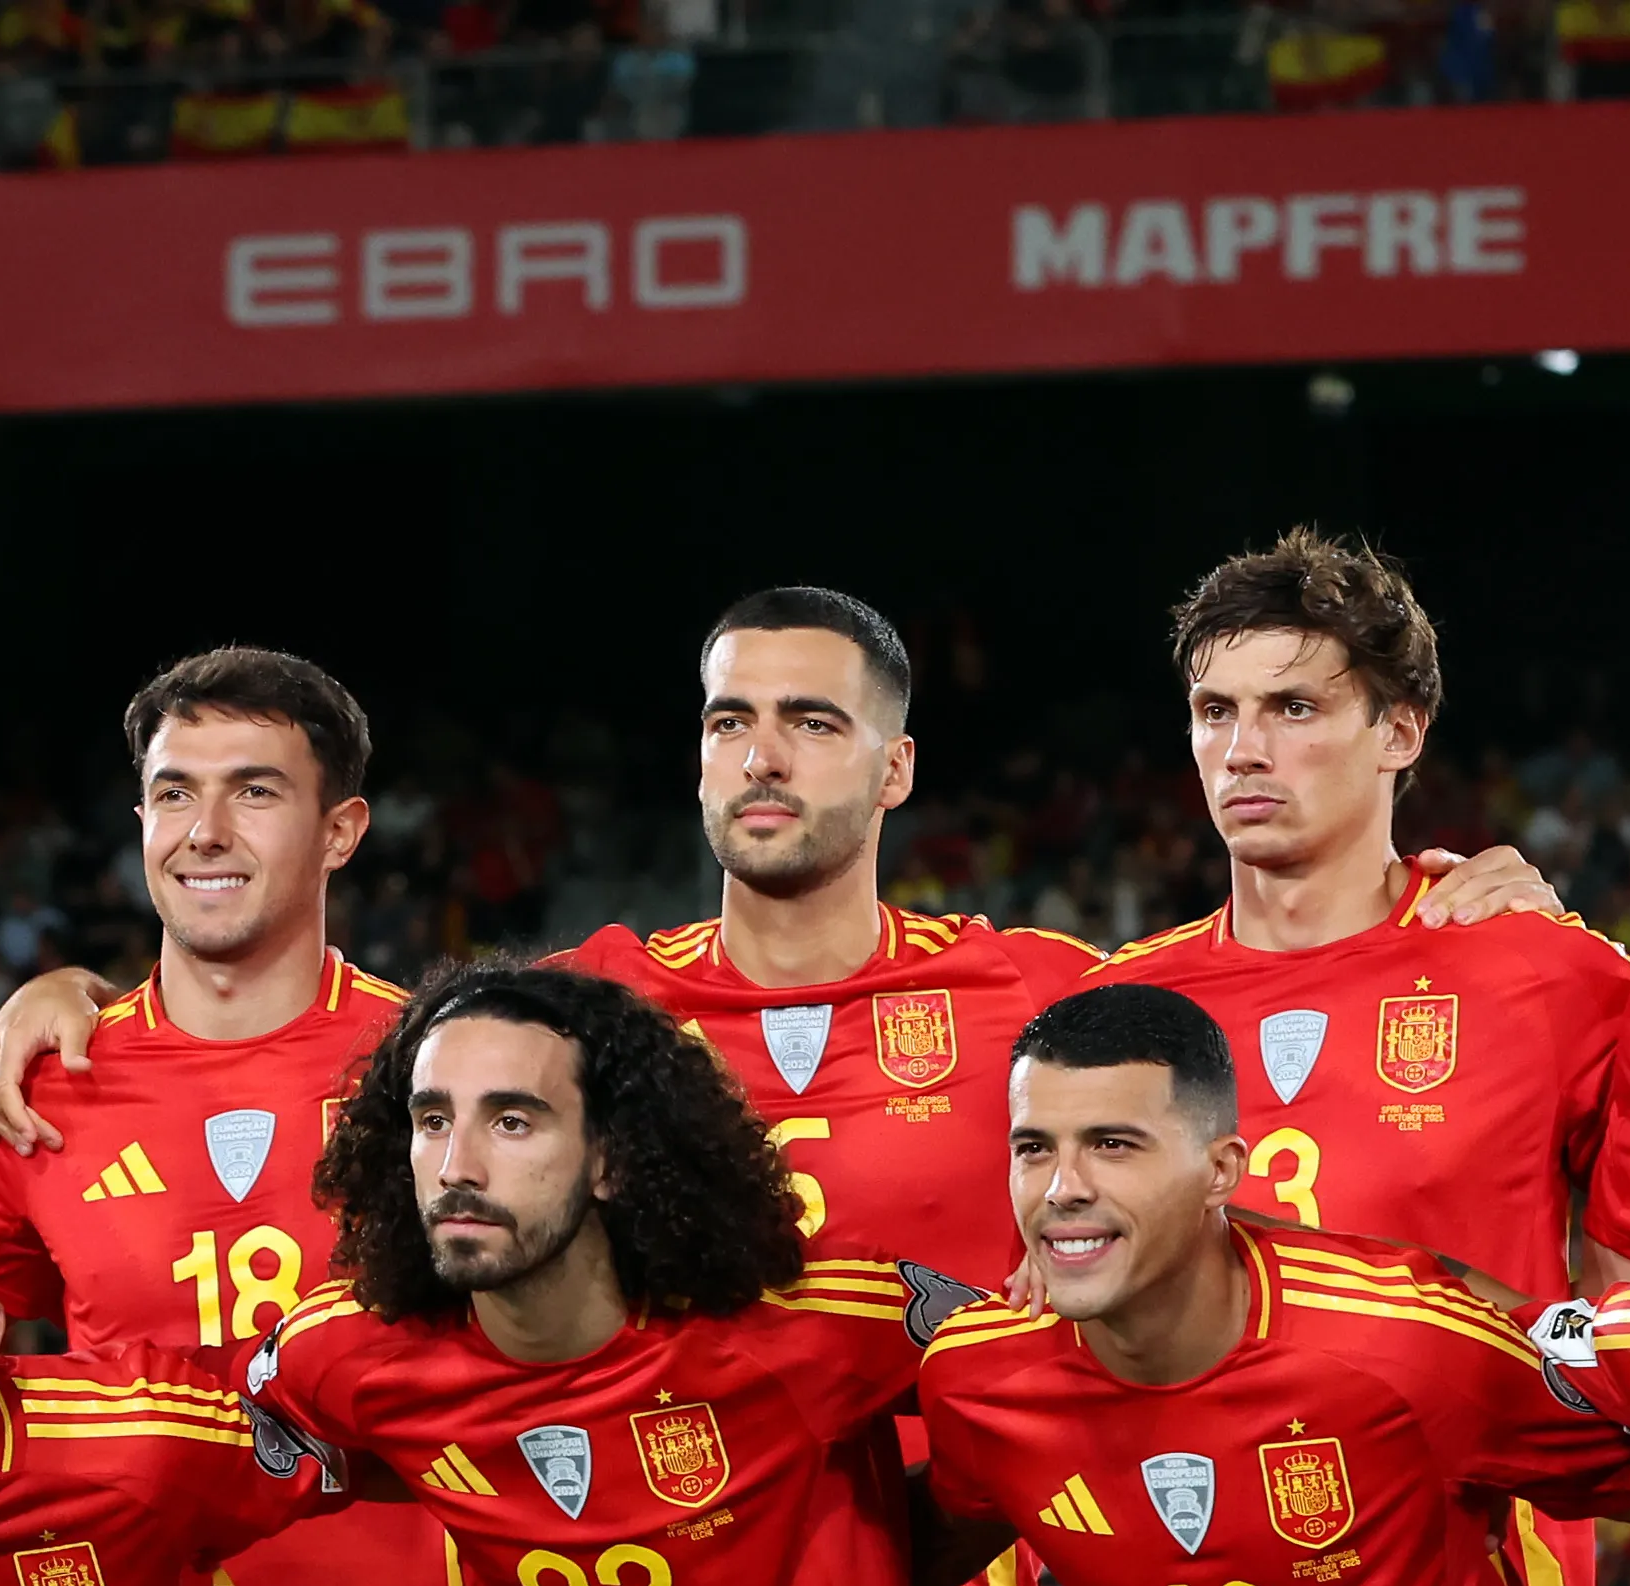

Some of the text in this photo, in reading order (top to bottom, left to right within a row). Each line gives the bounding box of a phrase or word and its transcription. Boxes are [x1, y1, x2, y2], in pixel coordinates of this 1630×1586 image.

[1013, 188, 1527, 290] MAPFRE
[769, 1011, 824, 1021] EUROPEAN
[768, 1019, 824, 1030] CHAMPIONS
[1267, 1022, 1320, 1034] EUROPEAN
[1266, 1031, 1320, 1042] CHAMPIONS
[784, 1060, 811, 1069] 2024
[888, 1096, 949, 1106] SPAIN GEORGIA
[894, 1105, 930, 1114] OCTOBER
[1380, 1104, 1444, 1114] SPAIN GEORGIA
[906, 1113, 930, 1123] ELCHE
[1387, 1113, 1422, 1123] OCTOBER
[213, 1121, 267, 1133] EUROPEAN
[213, 1130, 267, 1142] CHAMPIONS
[172, 1224, 303, 1347] 18
[526, 1437, 583, 1450] EUROPEAN
[530, 1447, 585, 1460] CHAMPIONS
[1149, 1466, 1207, 1479] EUROPEAN
[1152, 1477, 1208, 1489] CHAMPIONS
[553, 1486, 582, 1496] 2024
[1172, 1518, 1201, 1530] 2024
